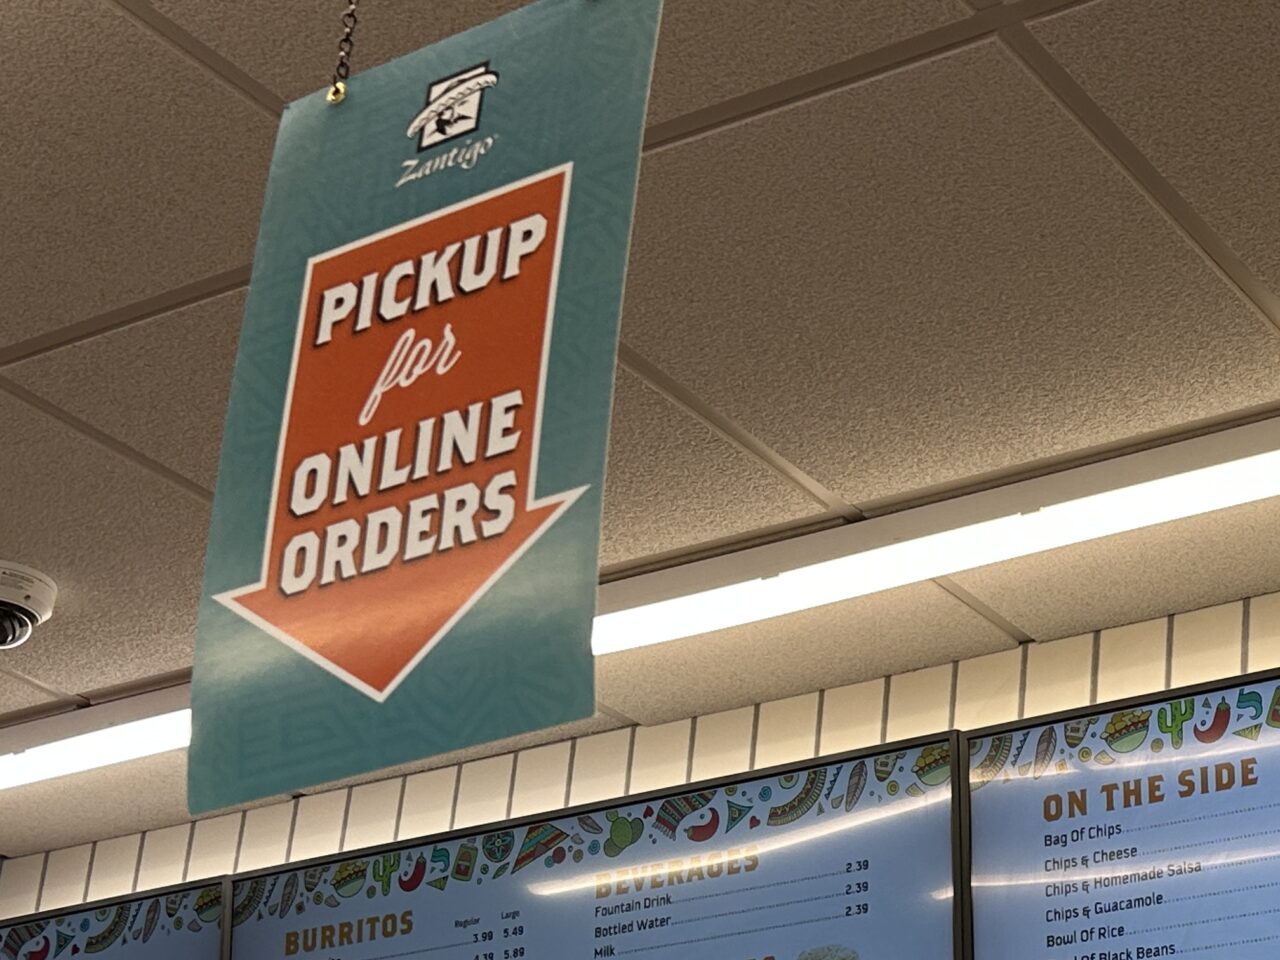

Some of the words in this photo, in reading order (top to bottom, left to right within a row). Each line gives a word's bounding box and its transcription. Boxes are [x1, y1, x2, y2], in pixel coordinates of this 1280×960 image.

[395, 136, 494, 188] Zantigo
[314, 212, 549, 346] PICKUP
[359, 327, 462, 426] for
[290, 389, 525, 517] ONLINE
[279, 472, 517, 595] ORDERS
[1043, 789, 1086, 821] ON
[1100, 775, 1164, 810] THE
[1177, 758, 1258, 797] SIDE
[1044, 833, 1067, 847] Bag
[1070, 826, 1085, 842] Of
[1088, 824, 1121, 839] Chips
[1044, 855, 1079, 873] Chips
[1080, 855, 1089, 867] &
[1092, 847, 1137, 863] Cheese
[594, 845, 760, 899] BEVERAGES
[594, 900, 640, 917] Fountain
[643, 893, 672, 908] Drink
[845, 859, 868, 872] 2.39
[285, 910, 413, 955] BURRITOS
[593, 944, 615, 958] Milk
[845, 903, 868, 916] 2.39
[594, 920, 633, 937] Bottled
[636, 916, 673, 930] Water
[845, 881, 868, 894] 2.39
[1046, 930, 1076, 947] Bowl
[1080, 927, 1095, 942] Of
[1098, 925, 1124, 939] Rice
